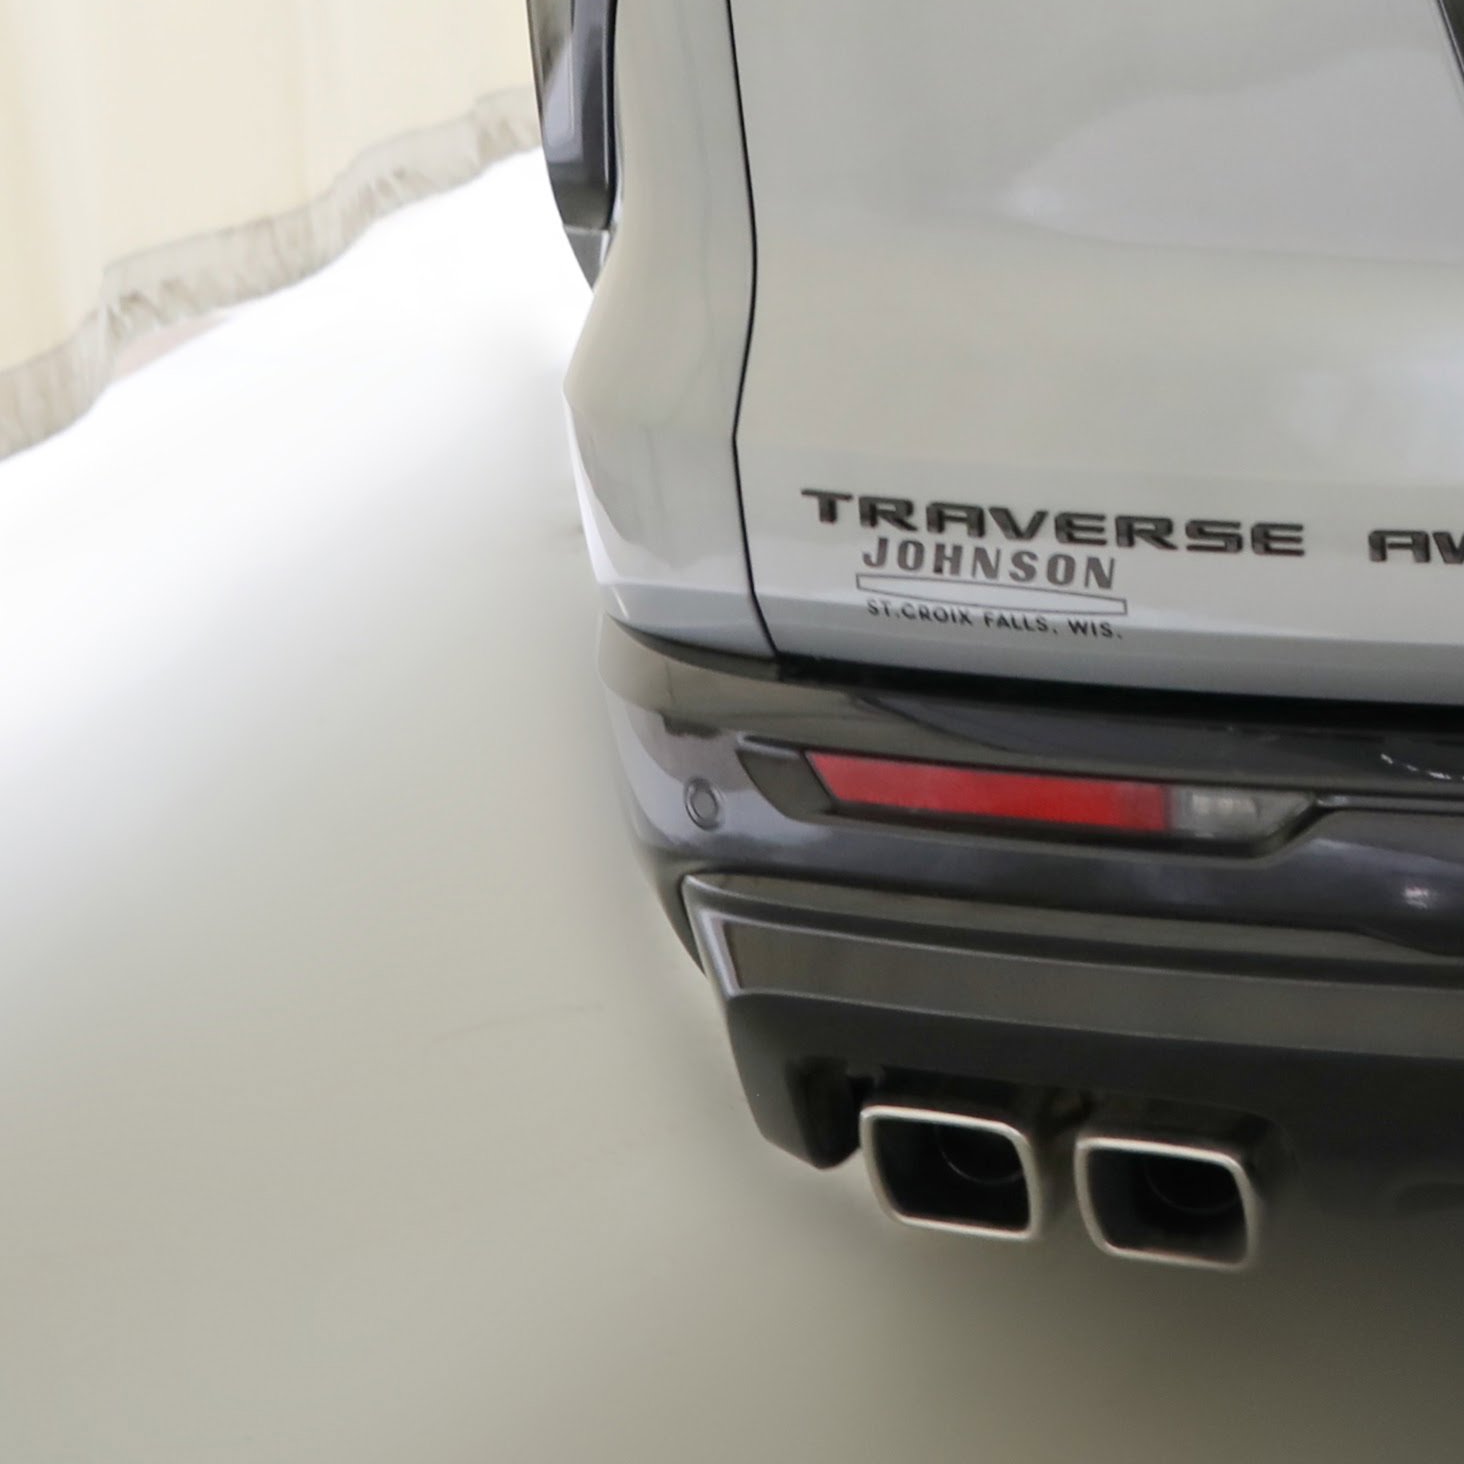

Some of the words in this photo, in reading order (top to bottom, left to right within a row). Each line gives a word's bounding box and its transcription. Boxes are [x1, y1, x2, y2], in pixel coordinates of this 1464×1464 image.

[801, 488, 1306, 558] TRAVERSE
[861, 536, 1116, 590] JOHNSON
[1067, 618, 1123, 640] WIS.
